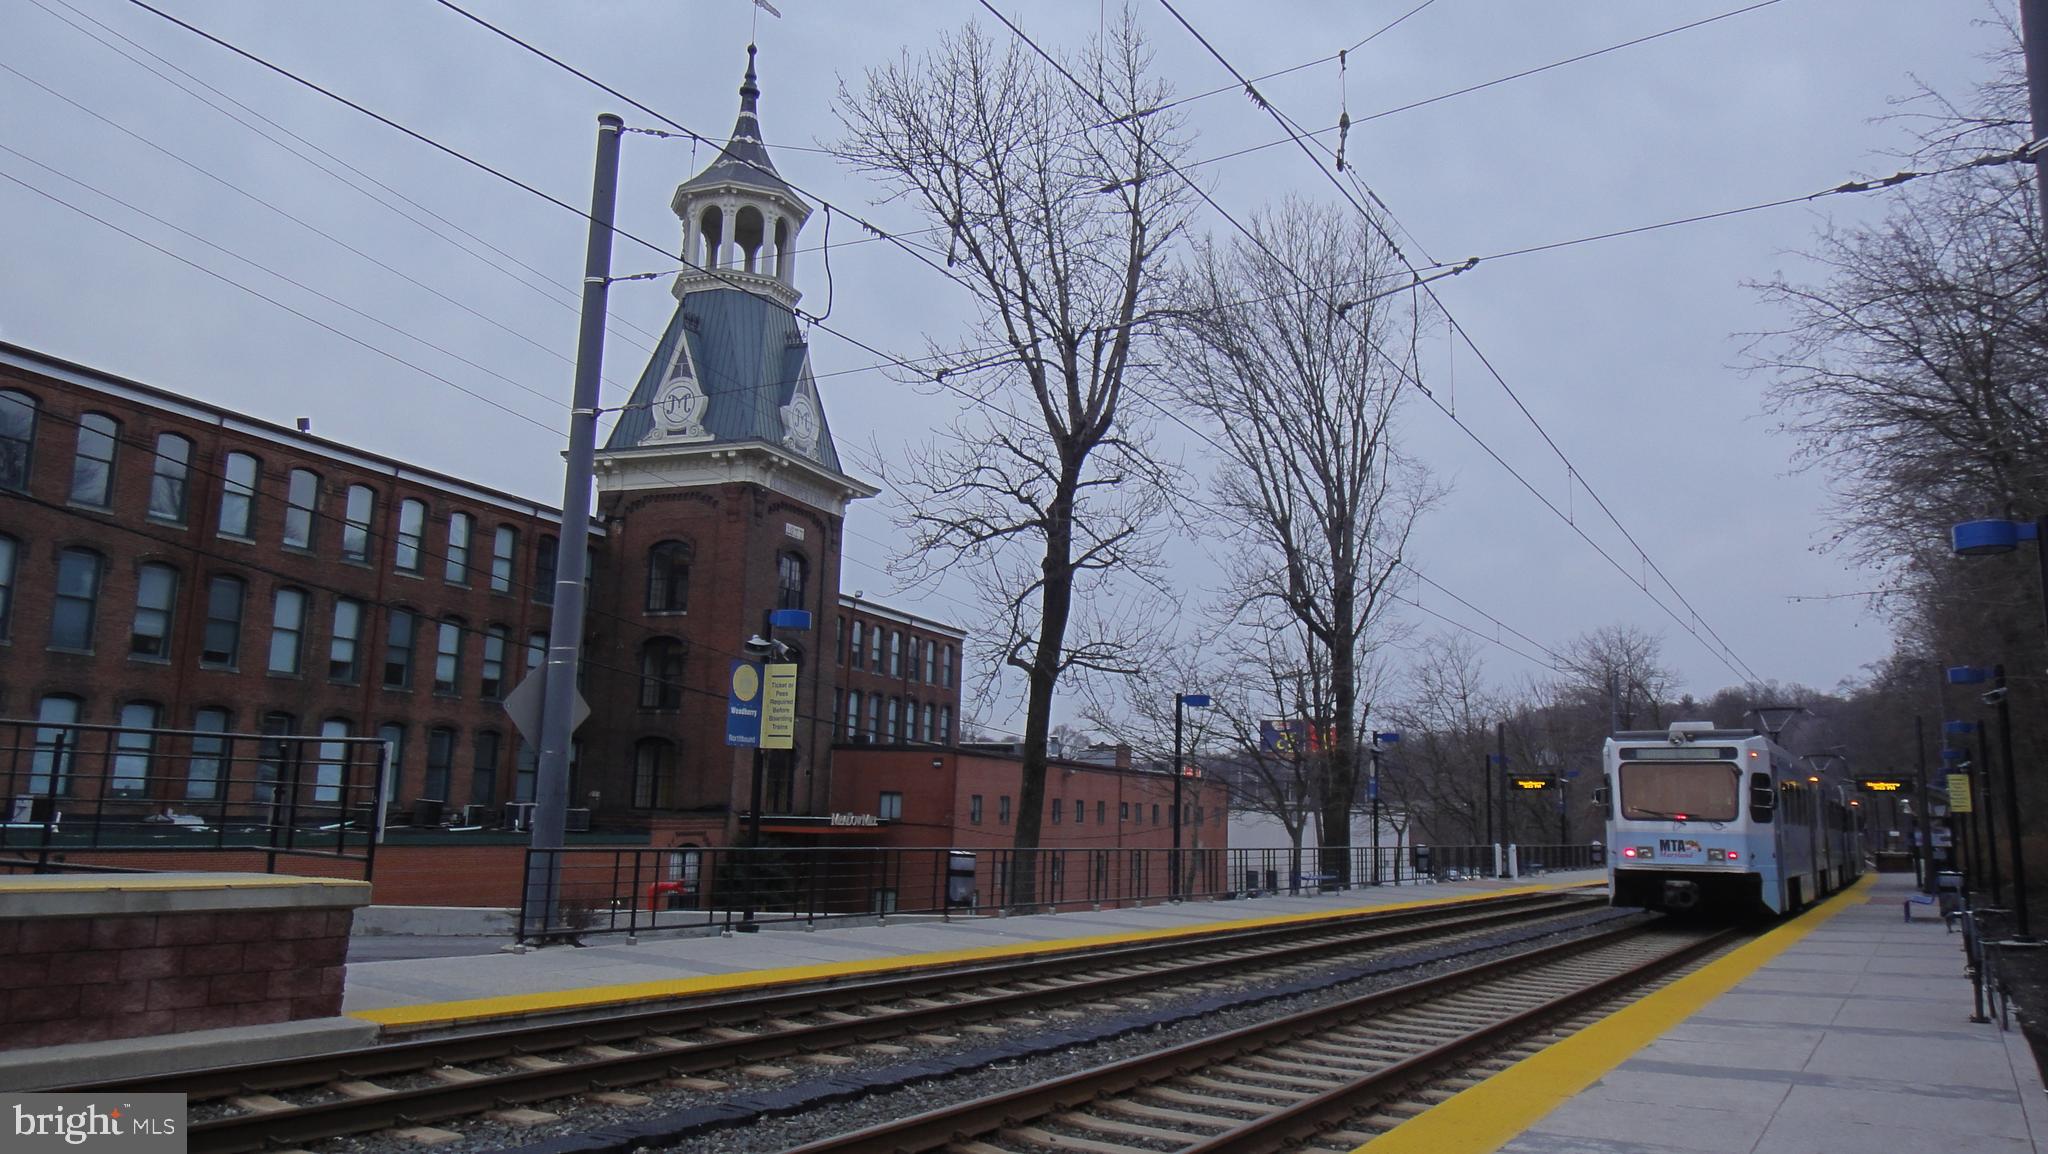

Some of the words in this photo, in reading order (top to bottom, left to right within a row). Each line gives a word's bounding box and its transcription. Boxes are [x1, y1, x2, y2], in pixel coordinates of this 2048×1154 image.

[666, 393, 692, 414] M
[730, 706, 757, 717] Woodberry
[1659, 839, 1686, 852] MTA
